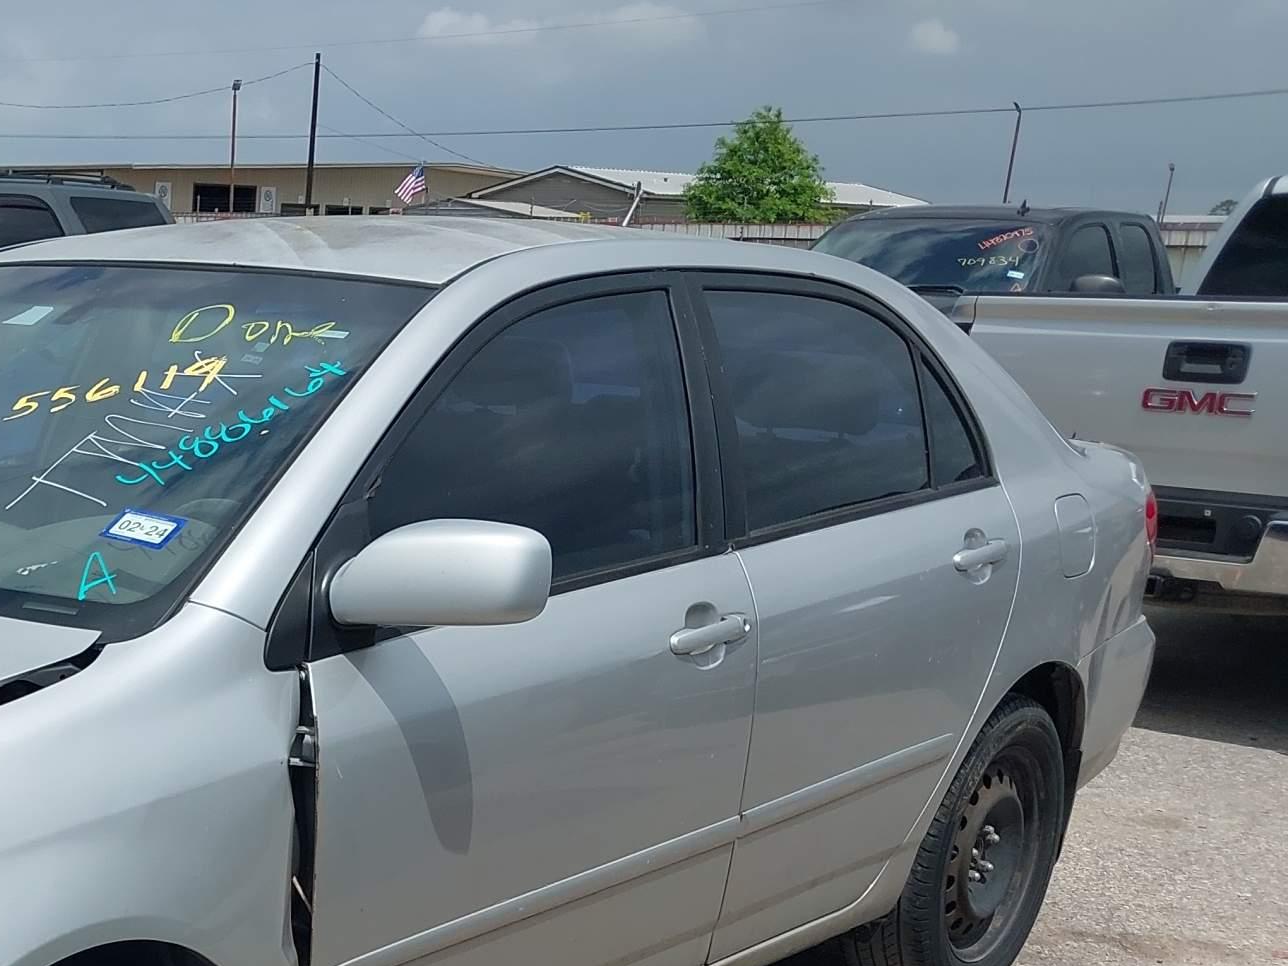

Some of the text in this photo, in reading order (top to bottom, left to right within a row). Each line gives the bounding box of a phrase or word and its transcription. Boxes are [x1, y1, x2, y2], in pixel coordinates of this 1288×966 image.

[957, 255, 1019, 267] 709834
[168, 304, 337, 345] Done
[2, 354, 229, 421] 556119
[1141, 386, 1257, 416] GMC
[114, 361, 347, 486] 44886164
[78, 551, 117, 600] A
